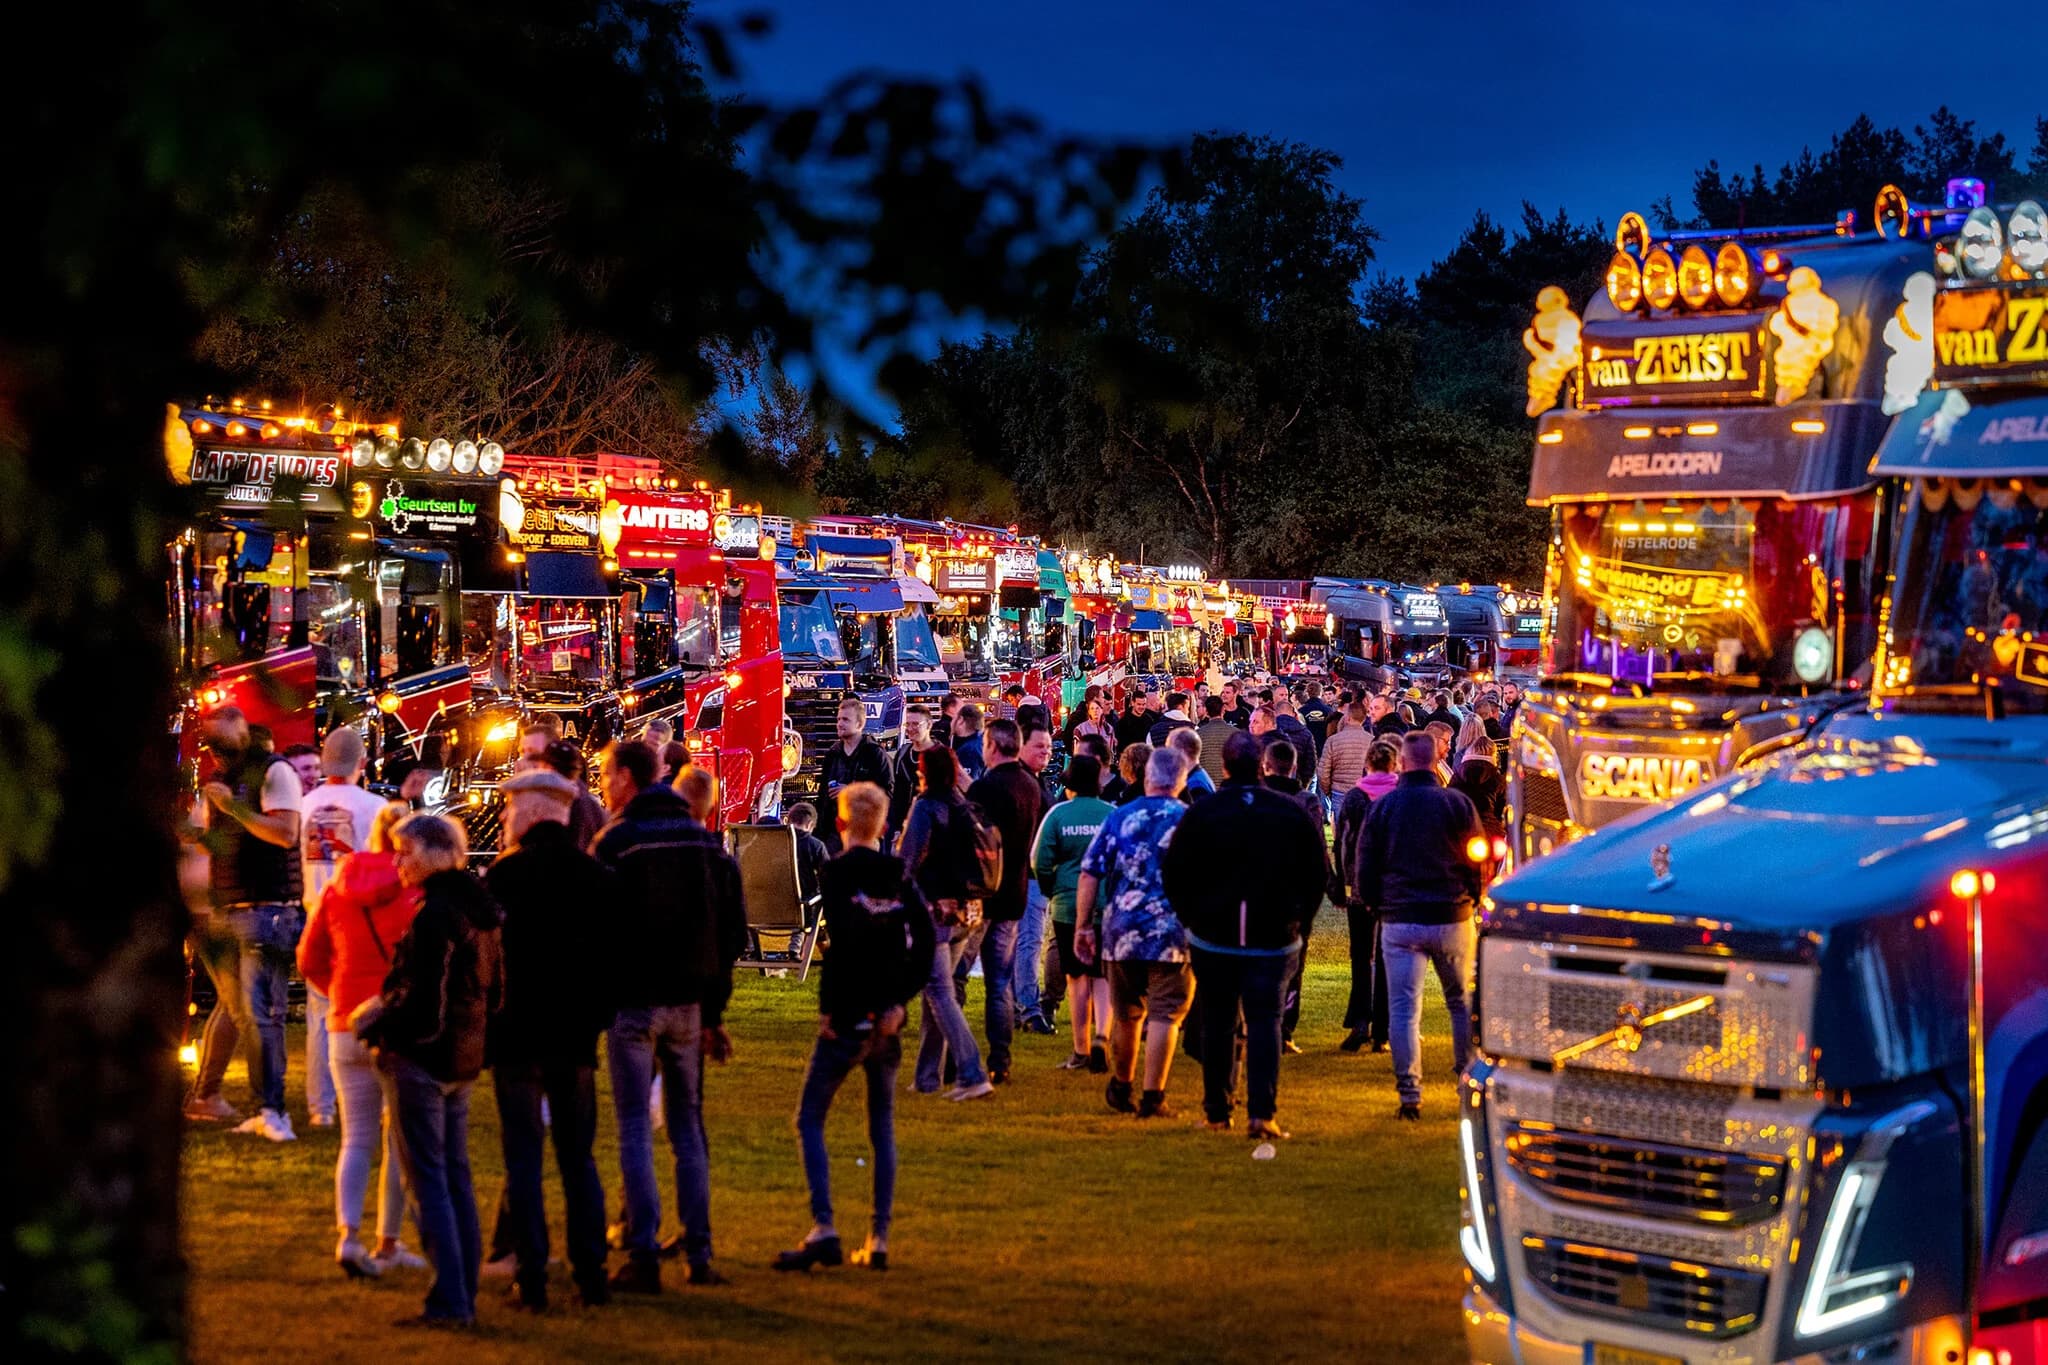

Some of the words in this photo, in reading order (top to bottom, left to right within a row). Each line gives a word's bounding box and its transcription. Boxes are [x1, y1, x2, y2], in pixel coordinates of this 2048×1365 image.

[1936, 328, 1999, 366] van
[2006, 297, 2048, 362] Z
[1586, 359, 1631, 387] van
[1634, 331, 1751, 385] ZEIST
[245, 454, 278, 485] DE
[1606, 452, 1723, 478] APELDOORN
[398, 496, 457, 512] Geurtsen
[459, 499, 476, 514] bv
[616, 504, 709, 531] KANTERS
[523, 505, 600, 535] eurtsen
[550, 534, 589, 546] EDERVEEN
[1613, 537, 1697, 550] NISTELRODE
[784, 676, 818, 689] CANIA
[902, 681, 921, 692] ANIA
[1583, 754, 1701, 801] SCANIA
